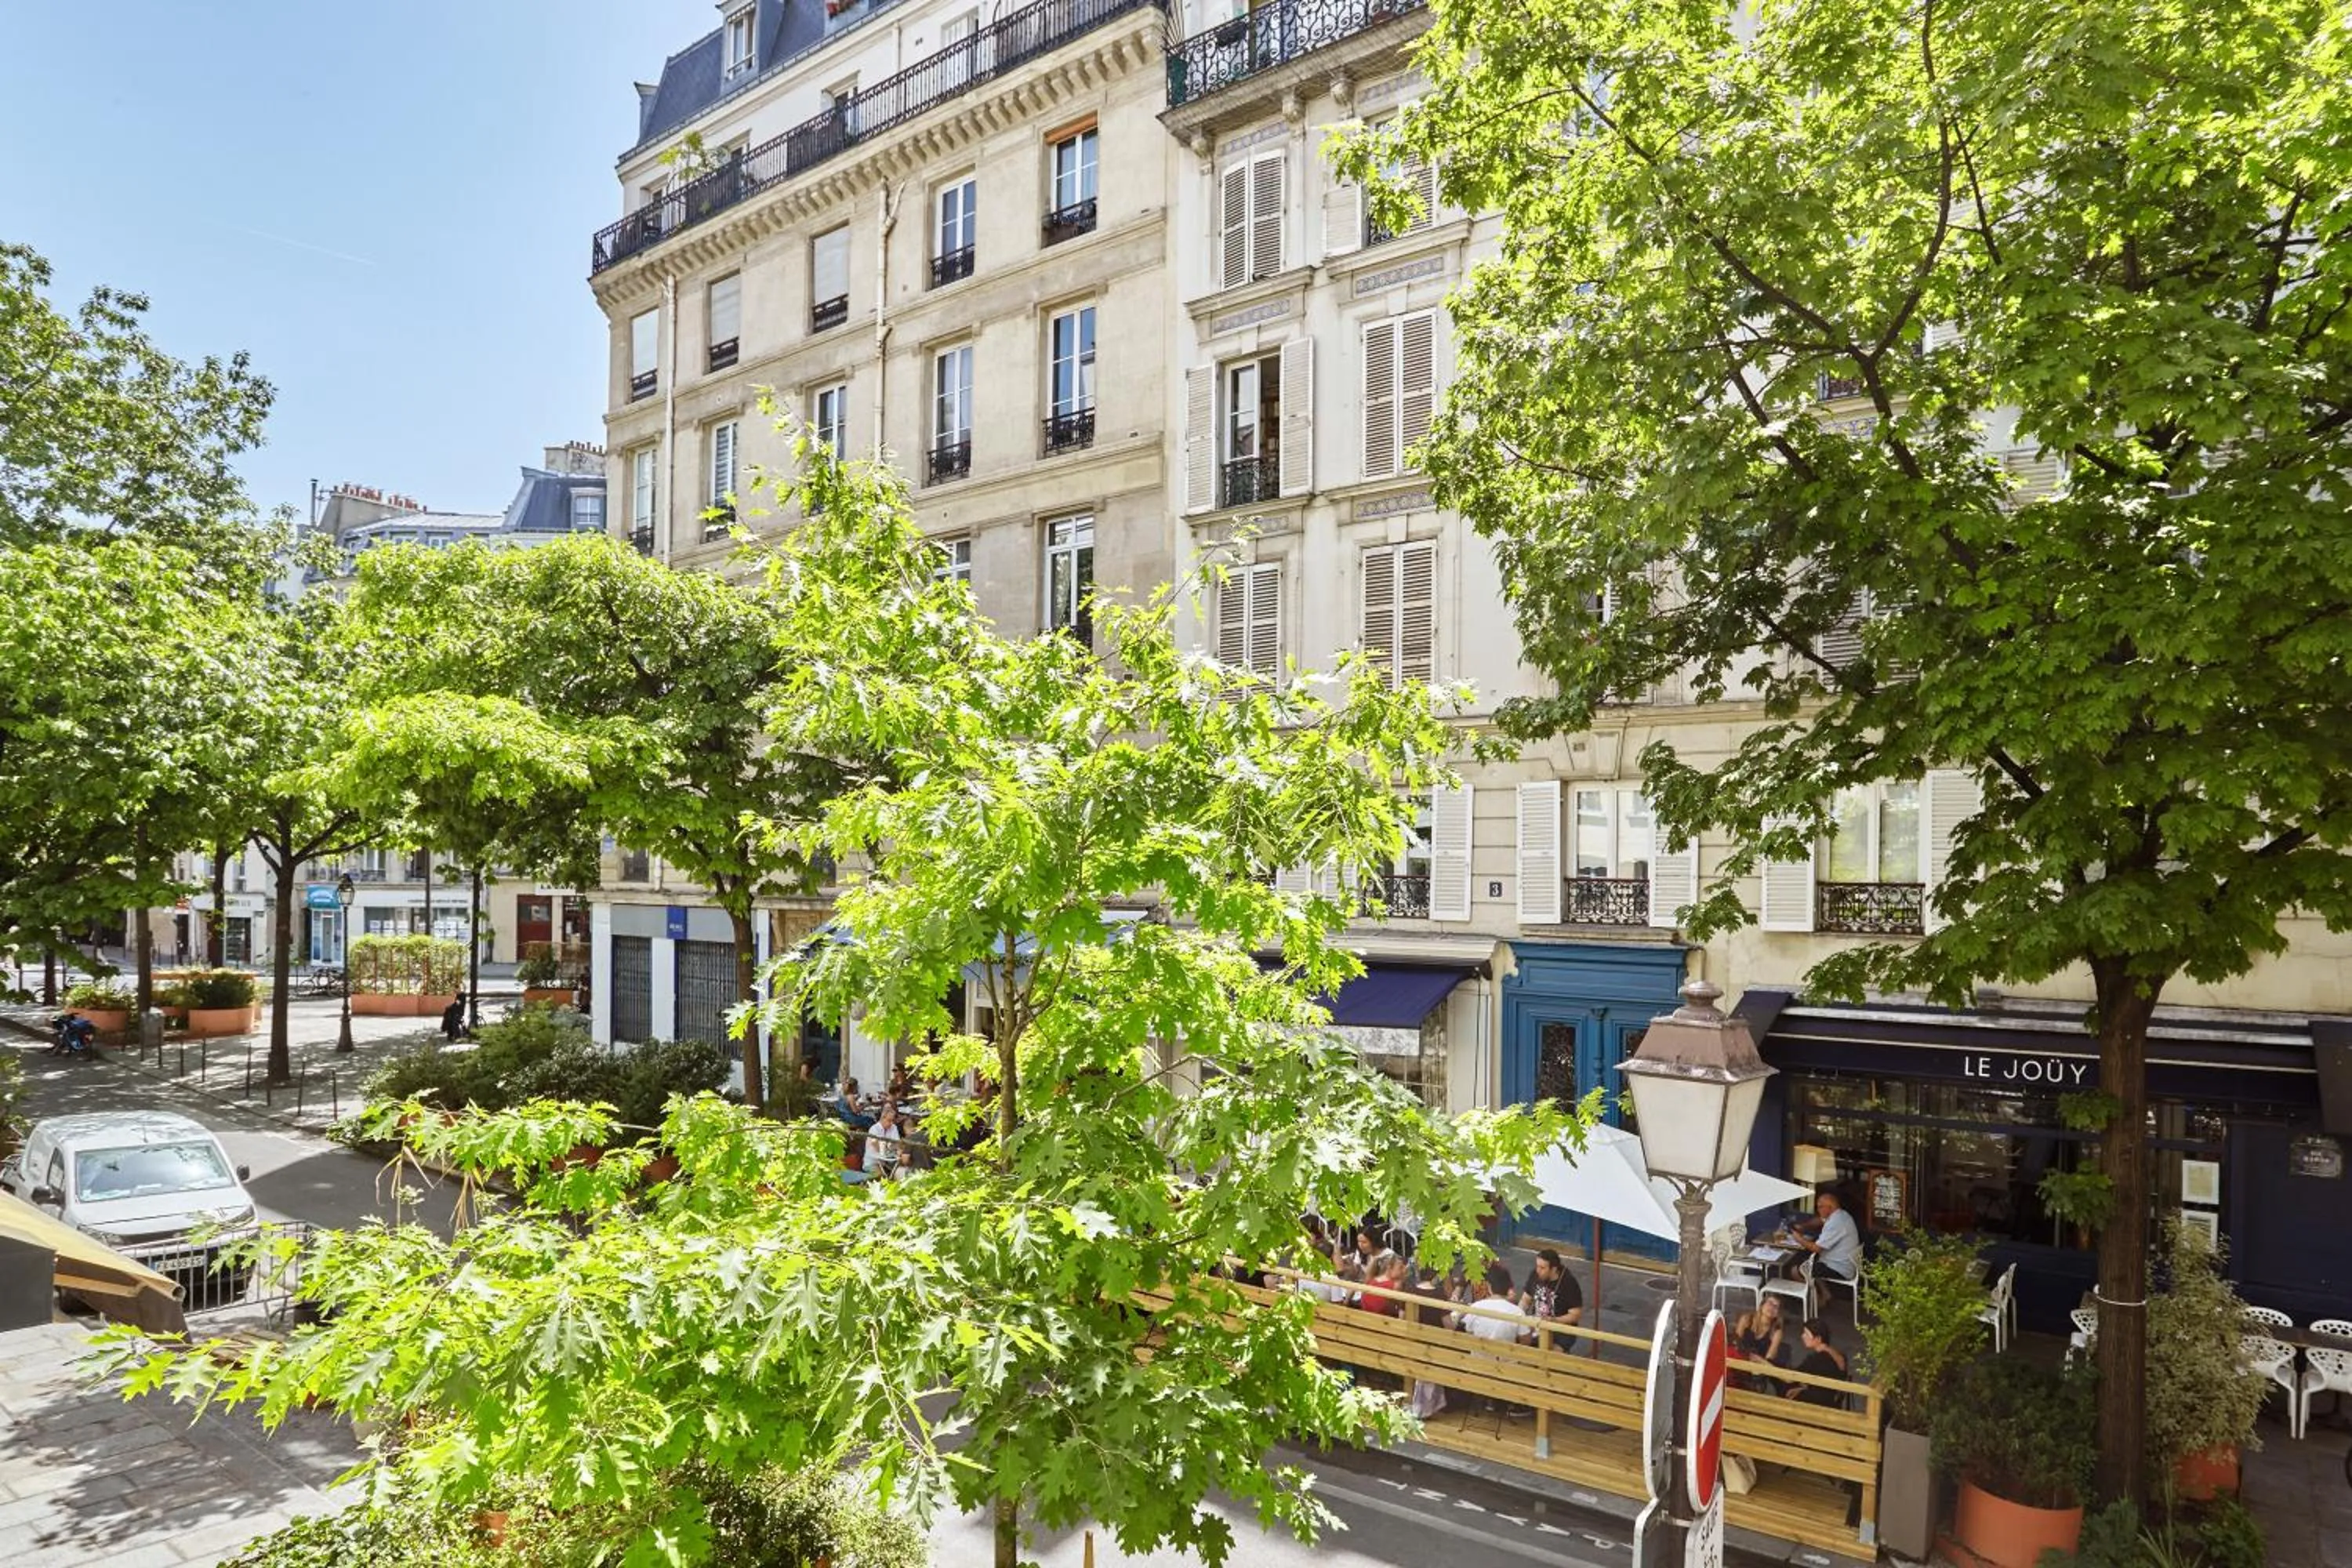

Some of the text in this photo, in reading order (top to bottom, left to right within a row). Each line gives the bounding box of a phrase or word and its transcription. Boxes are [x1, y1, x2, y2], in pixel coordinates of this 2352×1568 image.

[1492, 884, 1499, 895] 3
[1964, 1055, 2087, 1084] LE JOÜY
[1377, 1478, 1616, 1549] PAYANT
